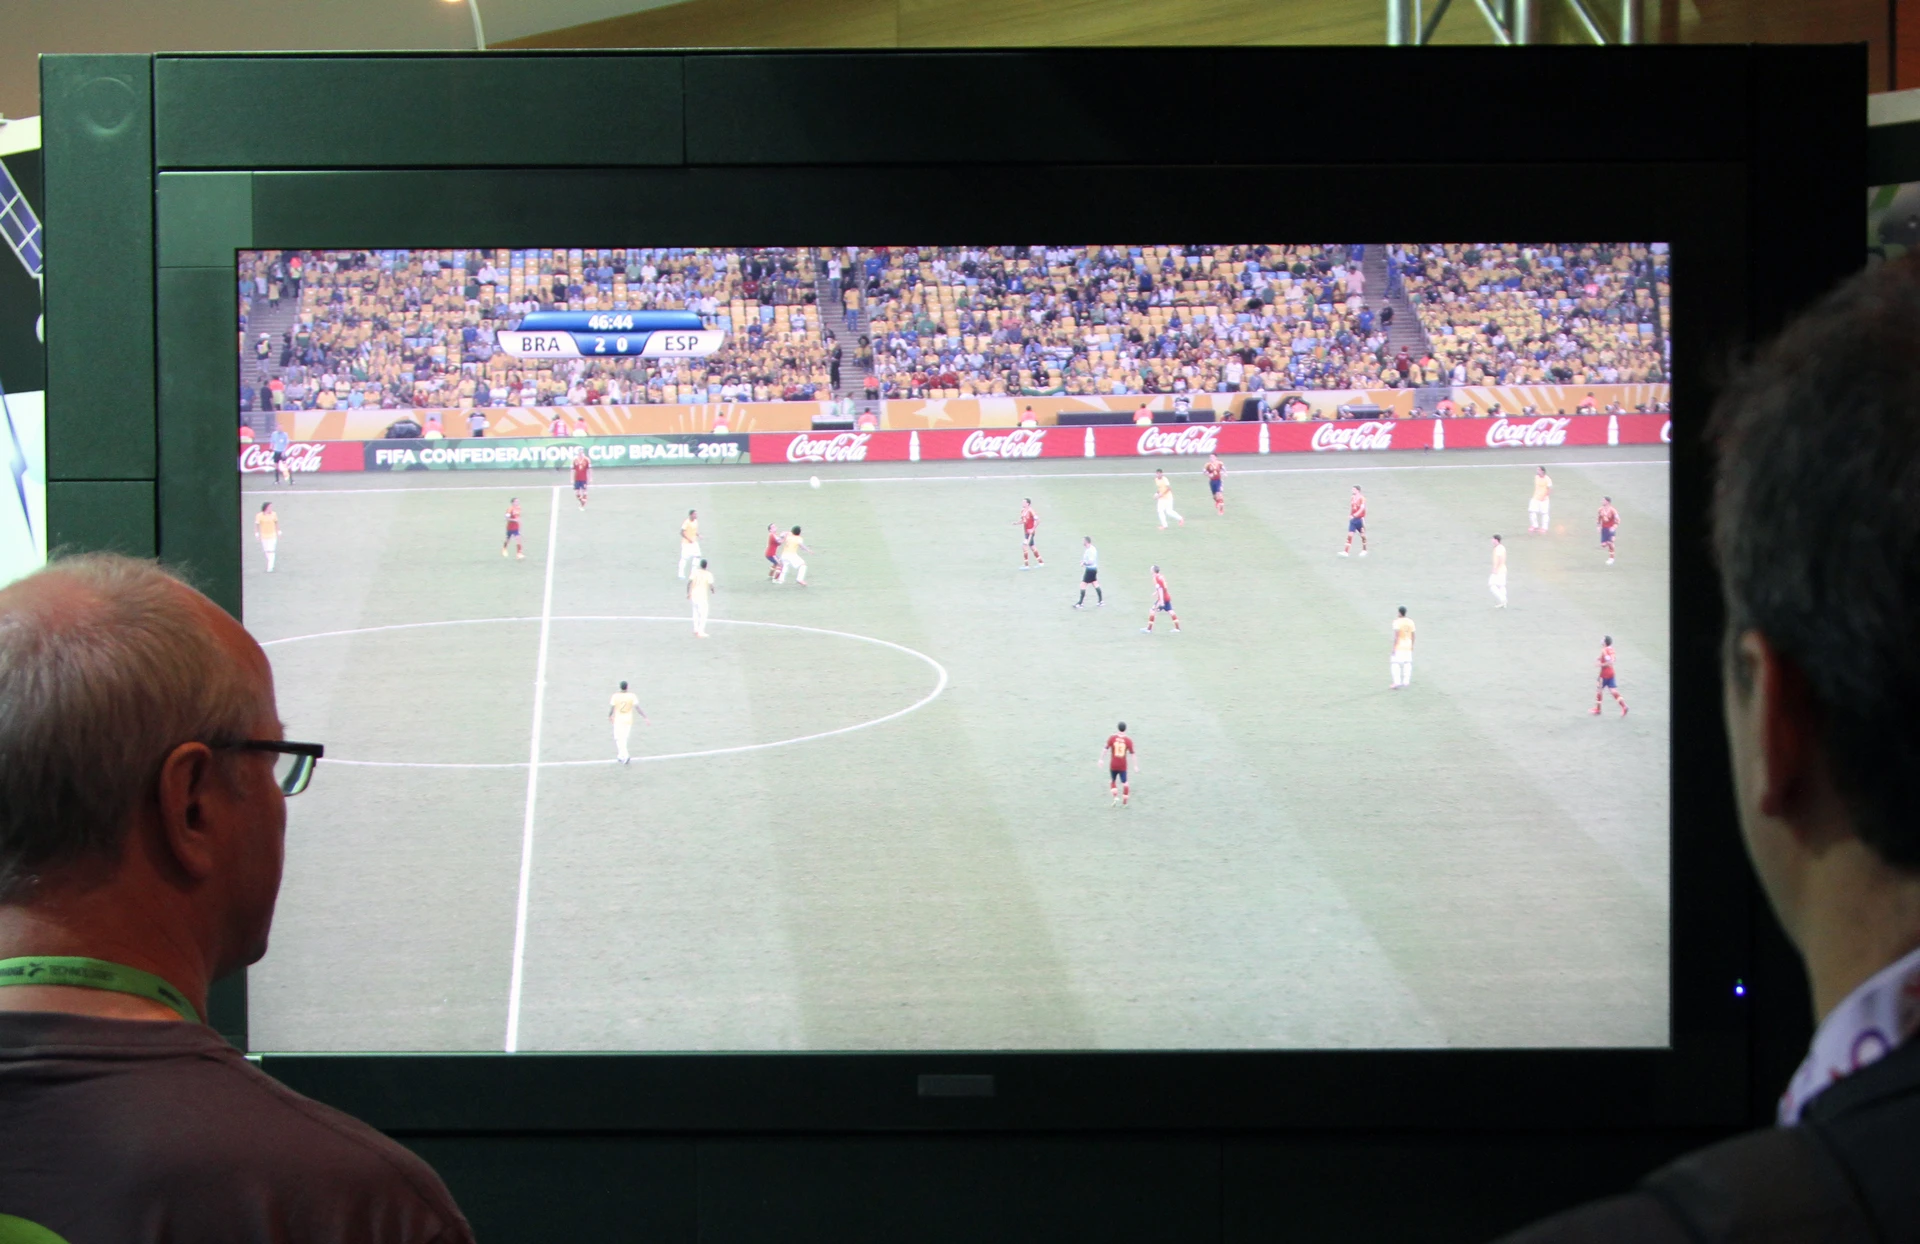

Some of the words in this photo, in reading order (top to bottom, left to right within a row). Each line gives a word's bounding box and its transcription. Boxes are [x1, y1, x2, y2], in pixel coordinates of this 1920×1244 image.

[588, 315, 634, 330] 46:44
[521, 337, 560, 351] BRA
[595, 337, 606, 352] 2
[616, 337, 628, 352] 0
[664, 336, 699, 350] ESP
[962, 429, 1047, 458] Coca-Cola
[1137, 425, 1222, 454] Coca-Cola
[1311, 421, 1396, 451] Coca-Cola
[1485, 417, 1571, 446] Coca-Cola
[240, 443, 326, 472] CocaCola
[376, 449, 417, 465] FIFA
[420, 446, 584, 464] CONFEDERATIONS
[588, 445, 626, 460] CUP
[629, 443, 695, 459] BRAZIL
[698, 442, 739, 457] 2013
[786, 433, 871, 462] Coca-Cola
